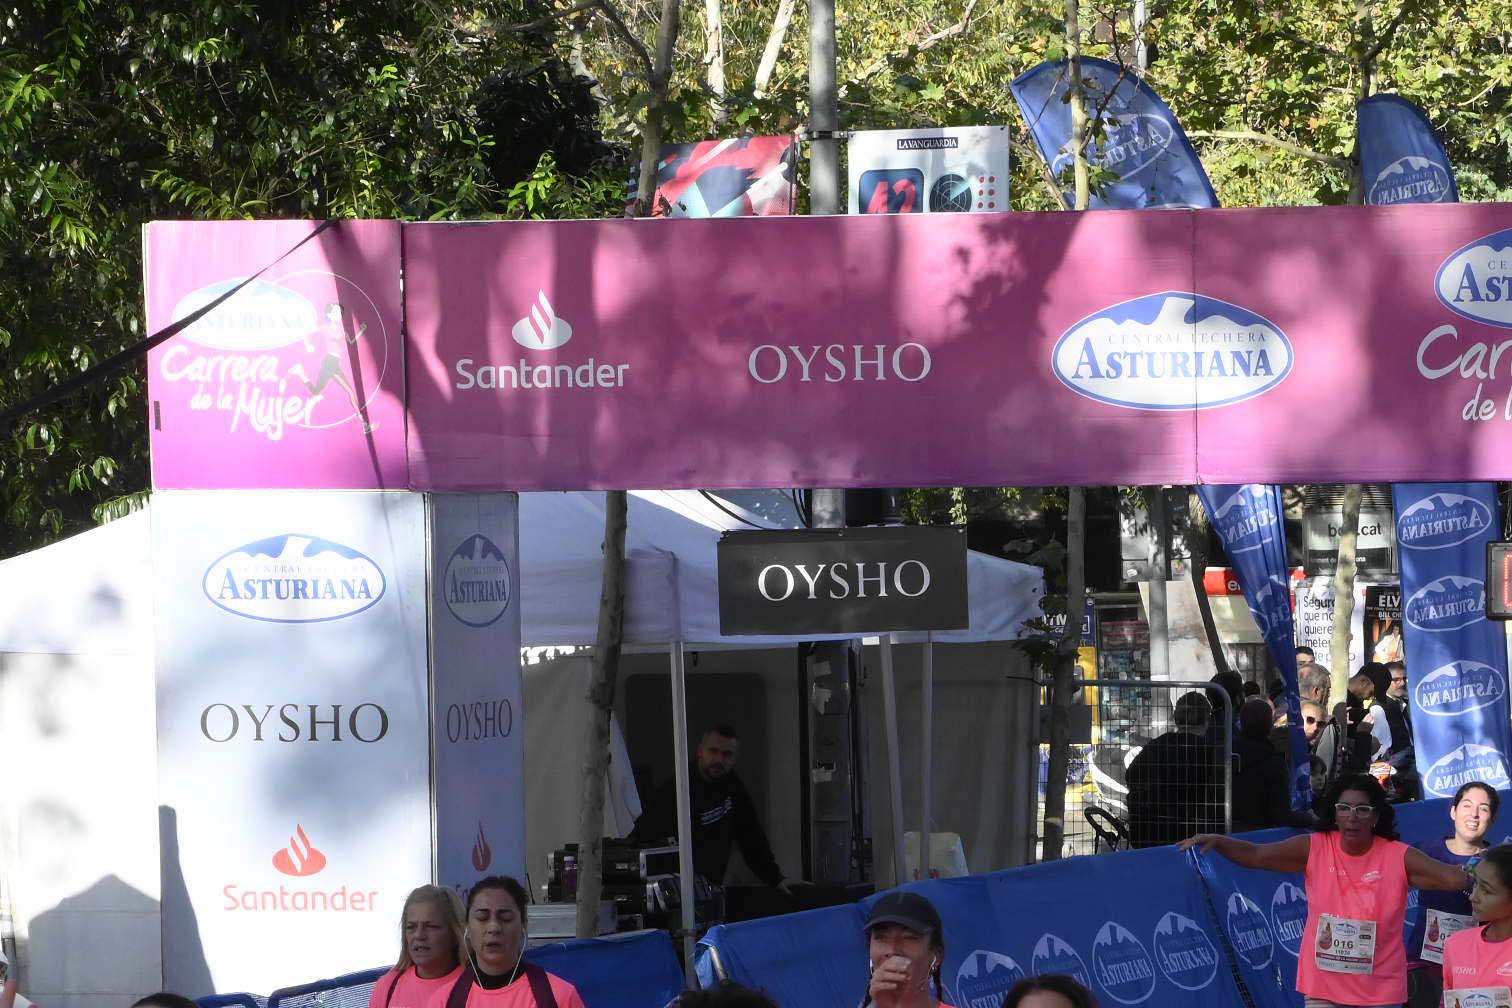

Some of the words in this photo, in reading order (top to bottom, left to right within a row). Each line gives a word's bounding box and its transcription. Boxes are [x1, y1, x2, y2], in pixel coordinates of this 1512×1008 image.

[1109, 333, 1182, 344] CENTRAL
[1191, 332, 1267, 344] LECHERA
[160, 344, 280, 383] Carrera
[456, 357, 630, 390] Santander
[748, 342, 932, 383] OYSHO
[1072, 337, 1274, 380] ASTURIANA
[191, 383, 212, 410] de
[231, 378, 324, 441] Mujer
[1462, 384, 1496, 421] de
[1328, 523, 1382, 538] b.cat
[218, 567, 373, 600] ASTURIANA
[450, 575, 507, 604] ASTURIANA
[758, 559, 931, 601] OYSHO
[200, 702, 389, 743] OYSHO
[446, 699, 512, 745] OYSHO
[223, 884, 379, 911] Santander
[1102, 957, 1153, 987] ASTURIANA
